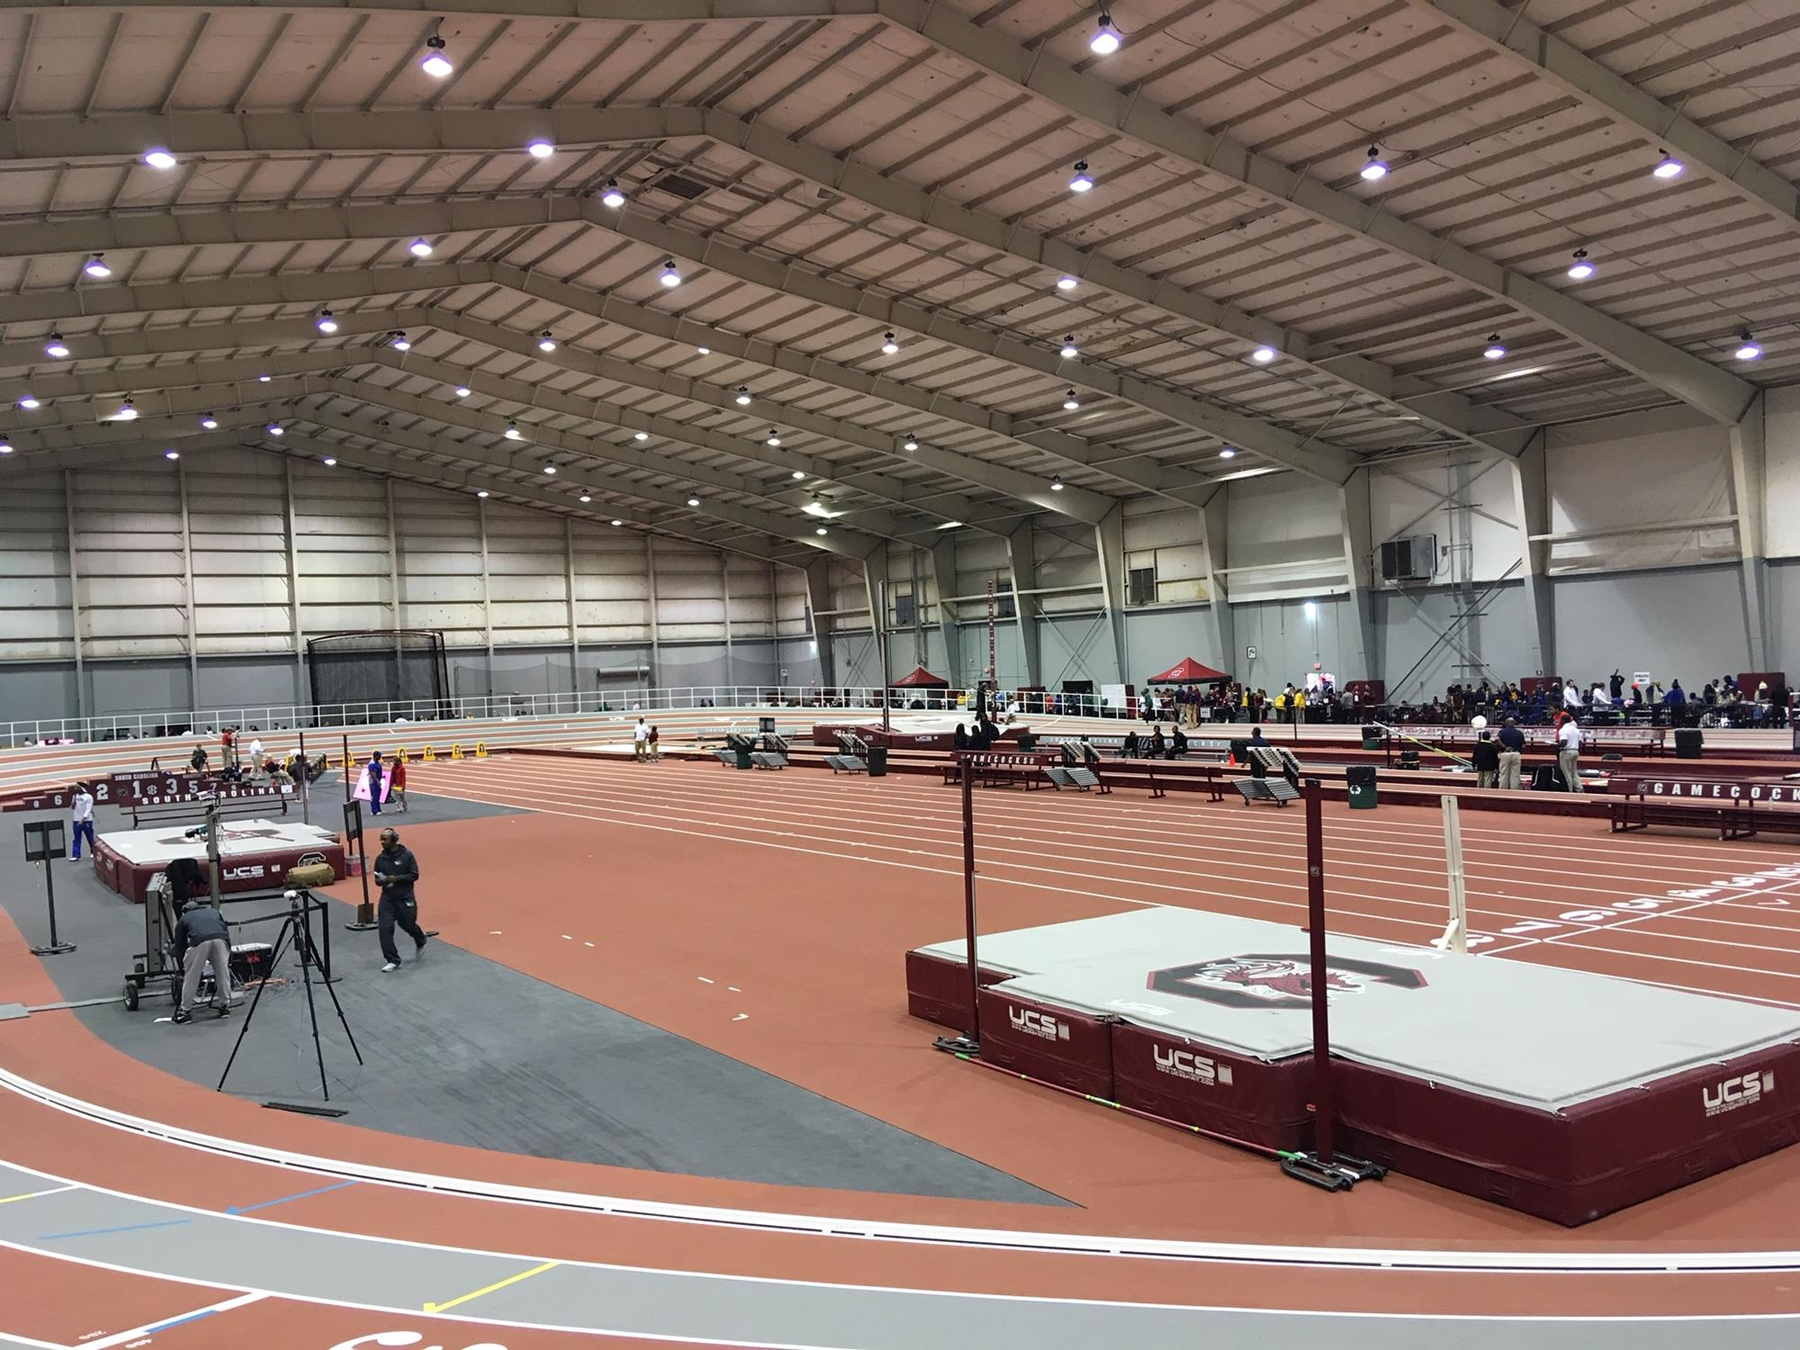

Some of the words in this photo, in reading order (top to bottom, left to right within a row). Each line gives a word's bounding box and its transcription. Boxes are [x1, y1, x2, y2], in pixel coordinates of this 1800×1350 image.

[96, 783, 109, 800] 2
[133, 780, 142, 798] 1
[166, 779, 177, 794] 3
[188, 780, 198, 793] 5
[54, 794, 62, 805] 6
[142, 794, 191, 805] SOUTH
[223, 866, 263, 878] UCS
[1711, 876, 1766, 887] 3
[1612, 898, 1673, 909] 5
[1559, 910, 1617, 921] 6
[1501, 920, 1562, 933] 7
[1009, 1005, 1057, 1034] UCS
[1153, 1044, 1215, 1079] UCS
[1703, 1071, 1761, 1108] UCS
